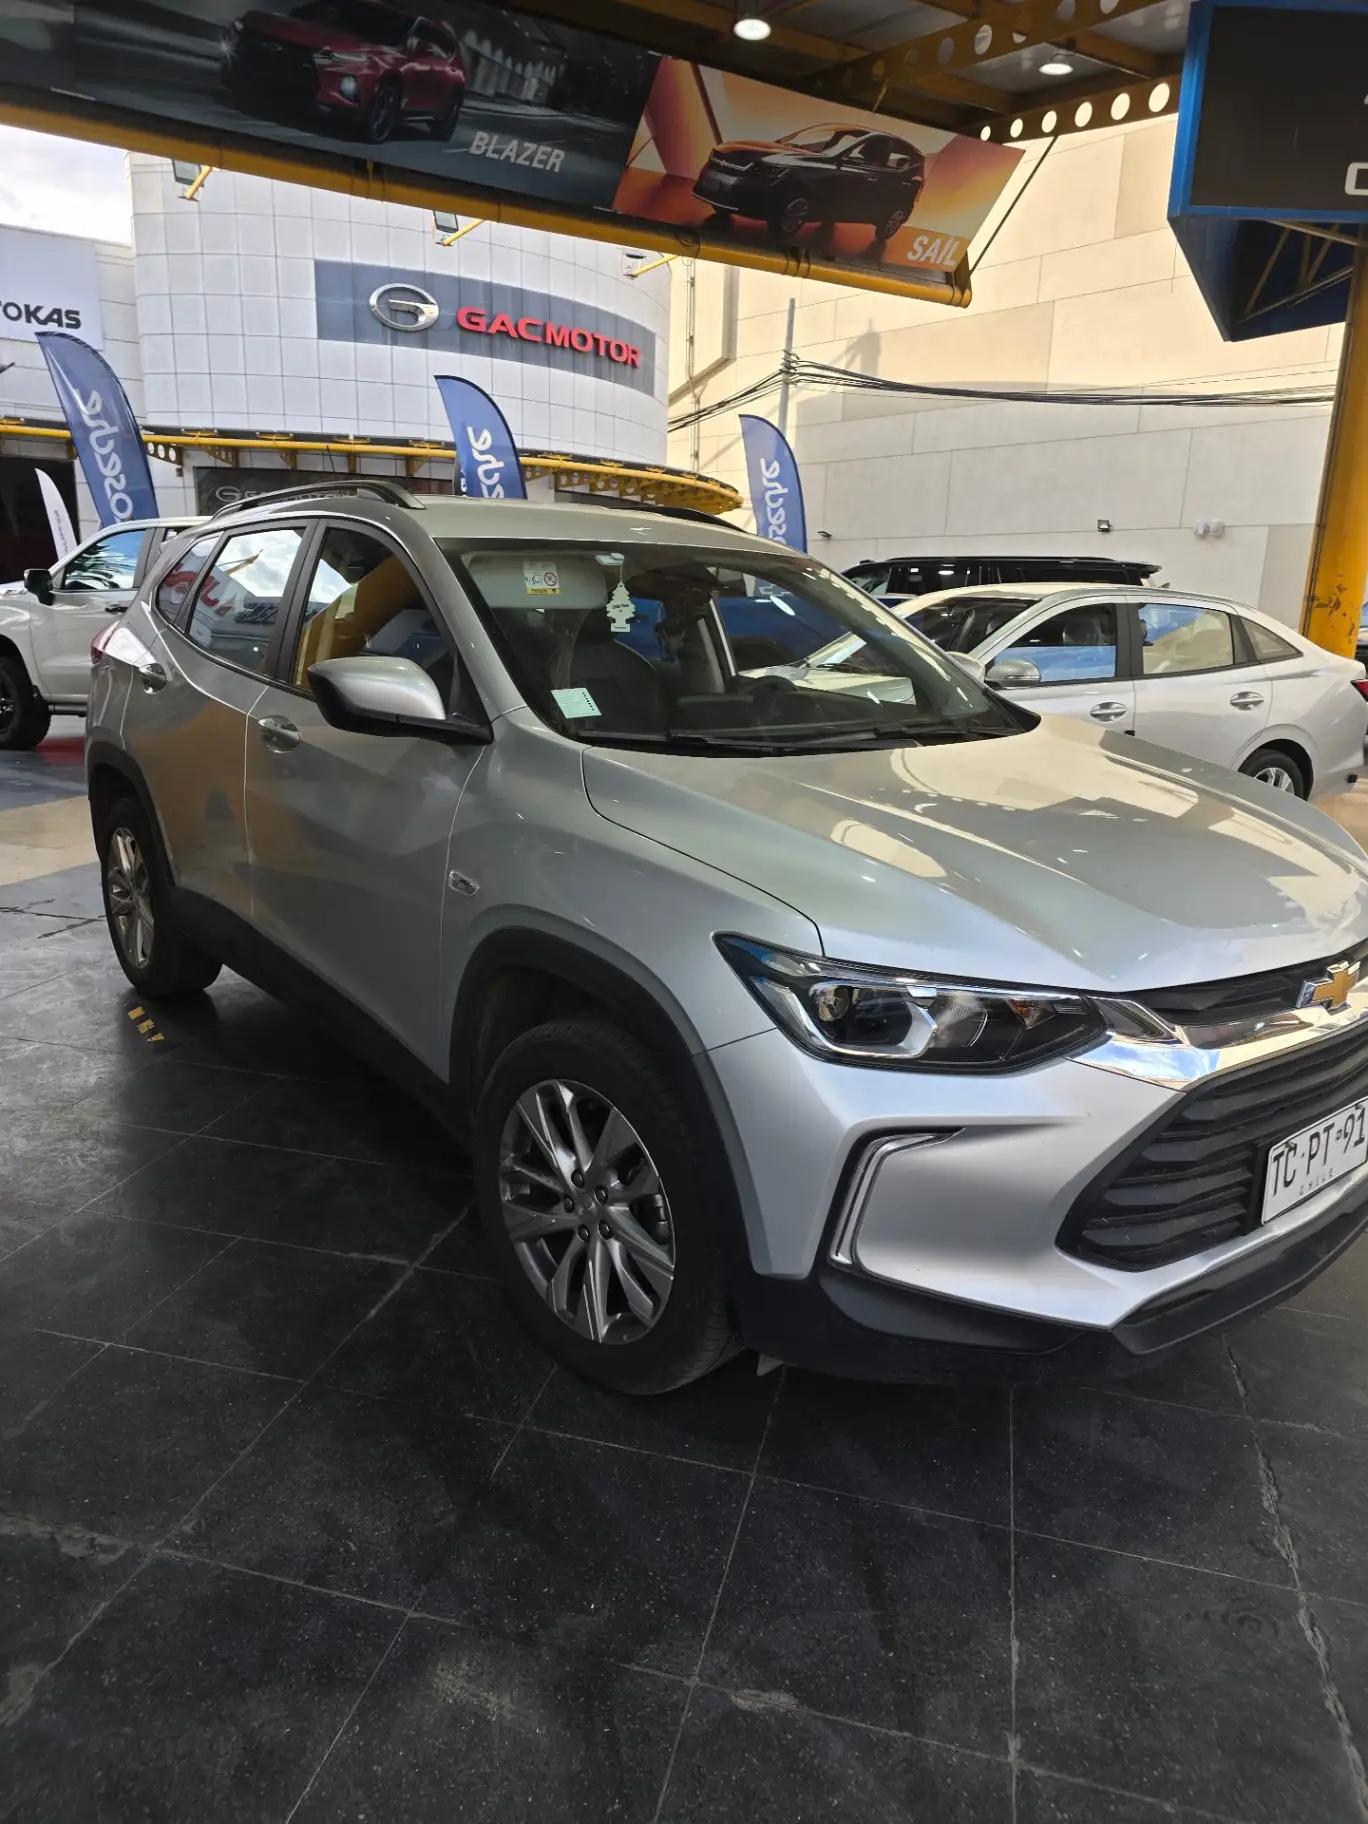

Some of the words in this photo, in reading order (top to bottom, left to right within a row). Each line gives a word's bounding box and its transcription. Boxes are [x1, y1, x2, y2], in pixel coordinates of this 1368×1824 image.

[469, 131, 565, 173] BLAZER
[907, 235, 960, 266] SAIL
[0, 301, 81, 329] OKAS
